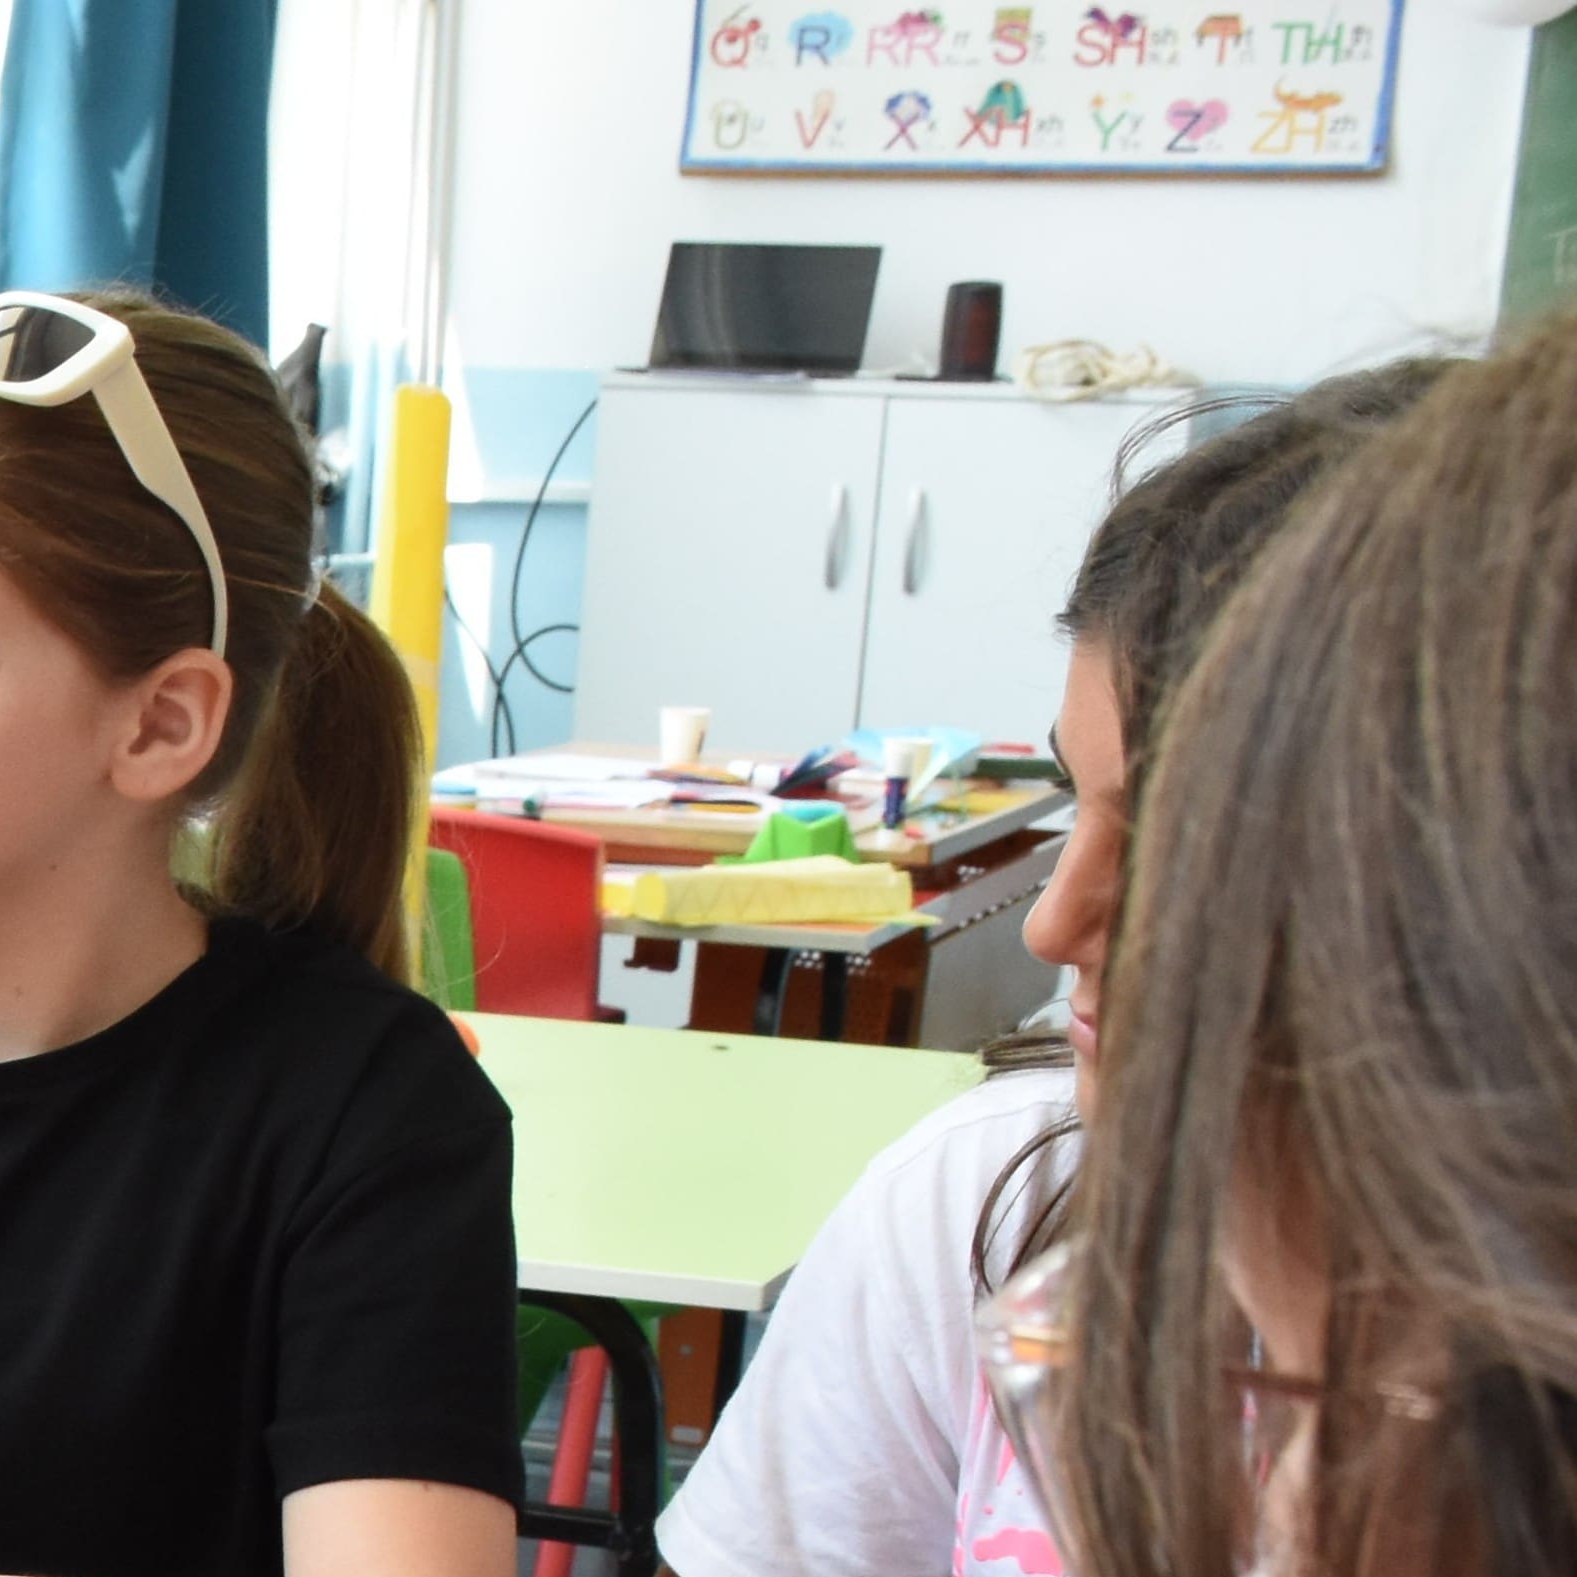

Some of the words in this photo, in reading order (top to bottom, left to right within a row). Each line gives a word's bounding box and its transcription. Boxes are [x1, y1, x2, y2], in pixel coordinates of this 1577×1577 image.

[795, 26, 831, 68] R
[866, 26, 941, 68] RR
[994, 22, 1030, 66] S
[1074, 24, 1147, 68] SH
[1272, 21, 1347, 65] TH
[795, 108, 832, 149] V
[884, 109, 920, 151] X
[958, 107, 1032, 148] XH
[1091, 110, 1128, 151] Y
[1165, 109, 1205, 153] Z
[1250, 108, 1326, 154] ZH
